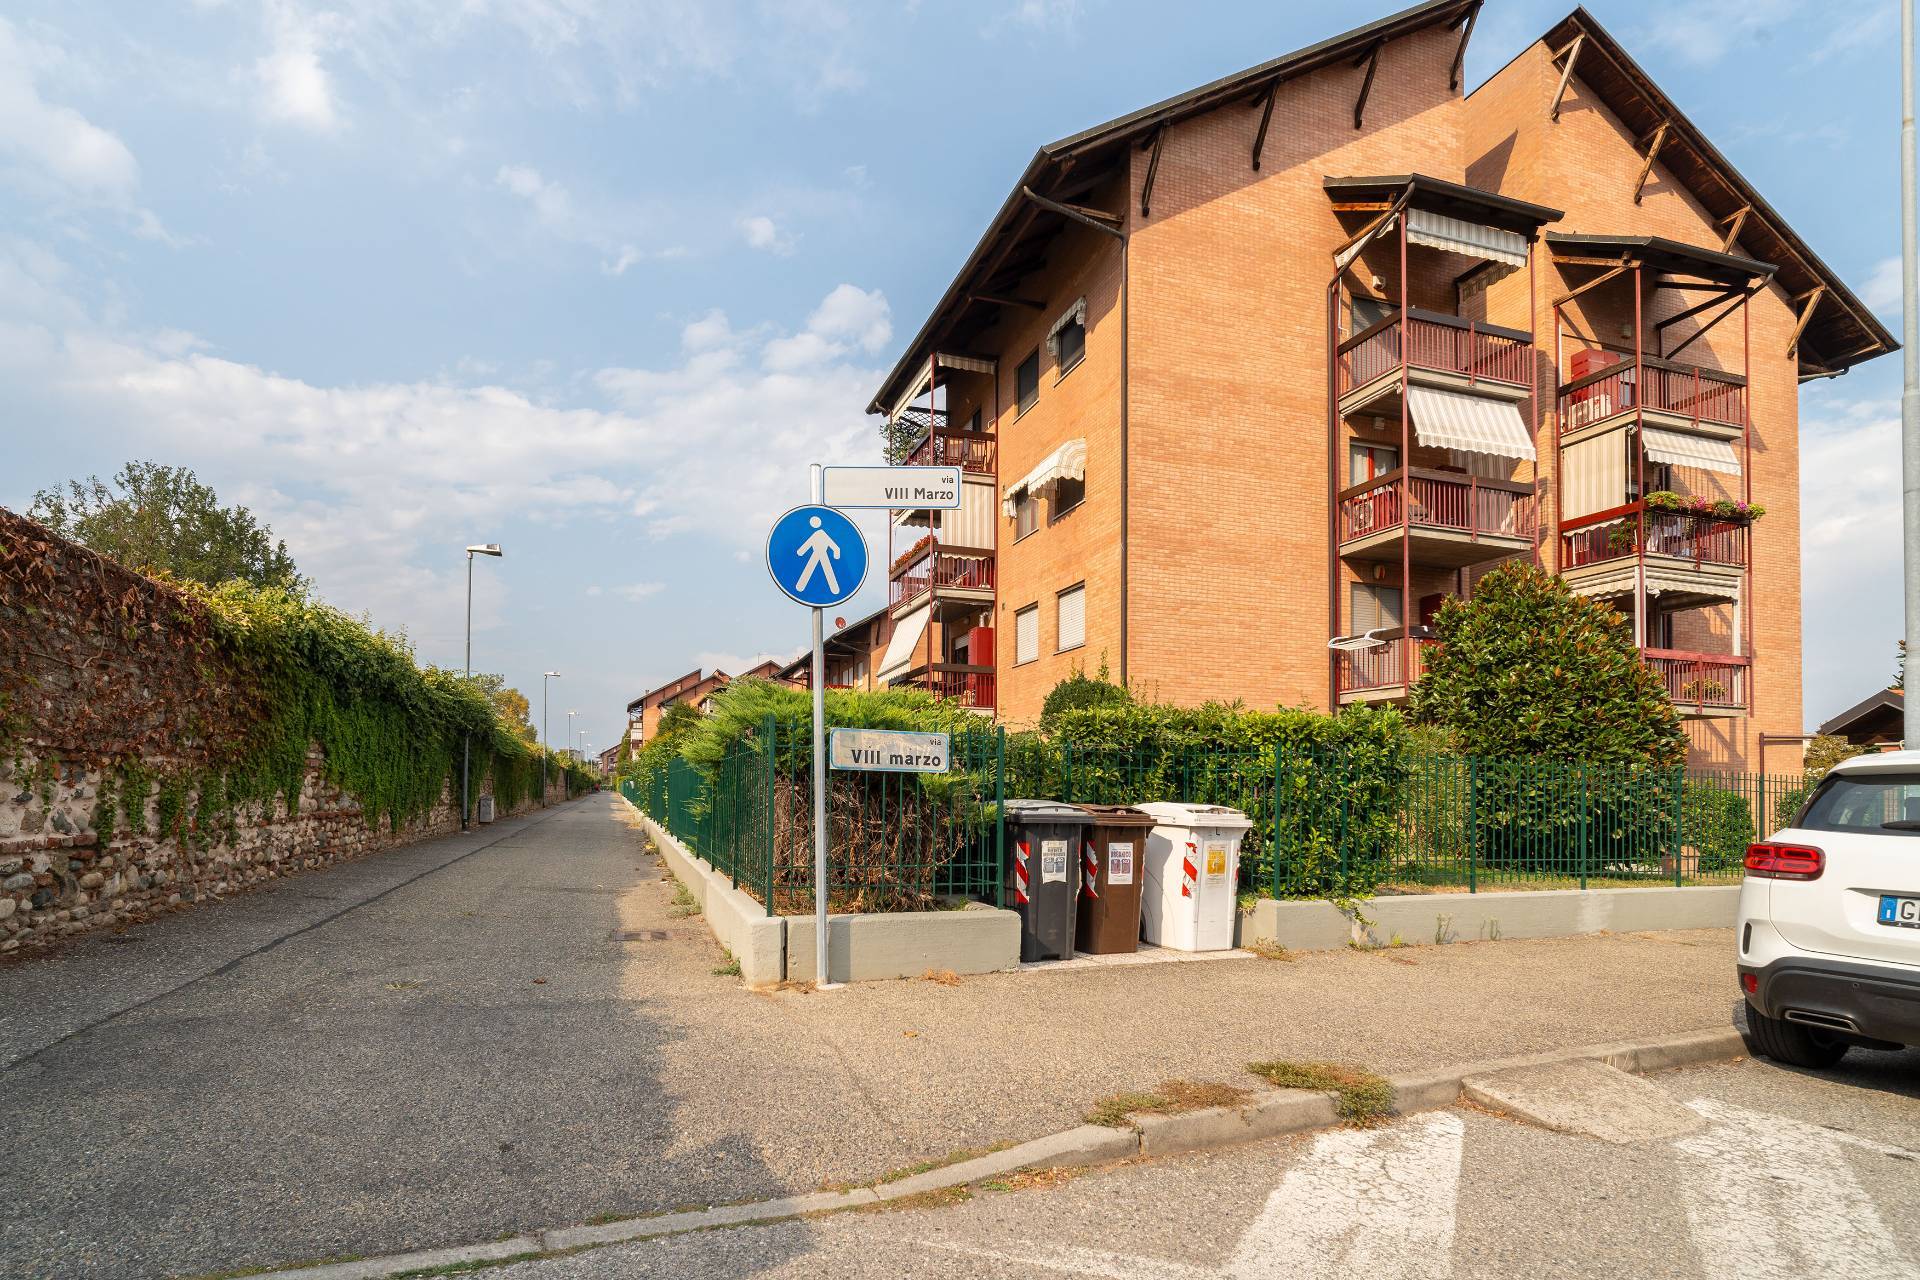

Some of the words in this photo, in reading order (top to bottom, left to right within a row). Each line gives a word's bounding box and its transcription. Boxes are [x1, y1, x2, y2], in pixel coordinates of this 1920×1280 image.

[941, 476, 954, 484] via
[885, 487, 909, 500] VIII
[914, 487, 954, 500] Marzo
[851, 749, 881, 765] VIII
[889, 753, 941, 767] marzo
[1901, 901, 1920, 920] G
